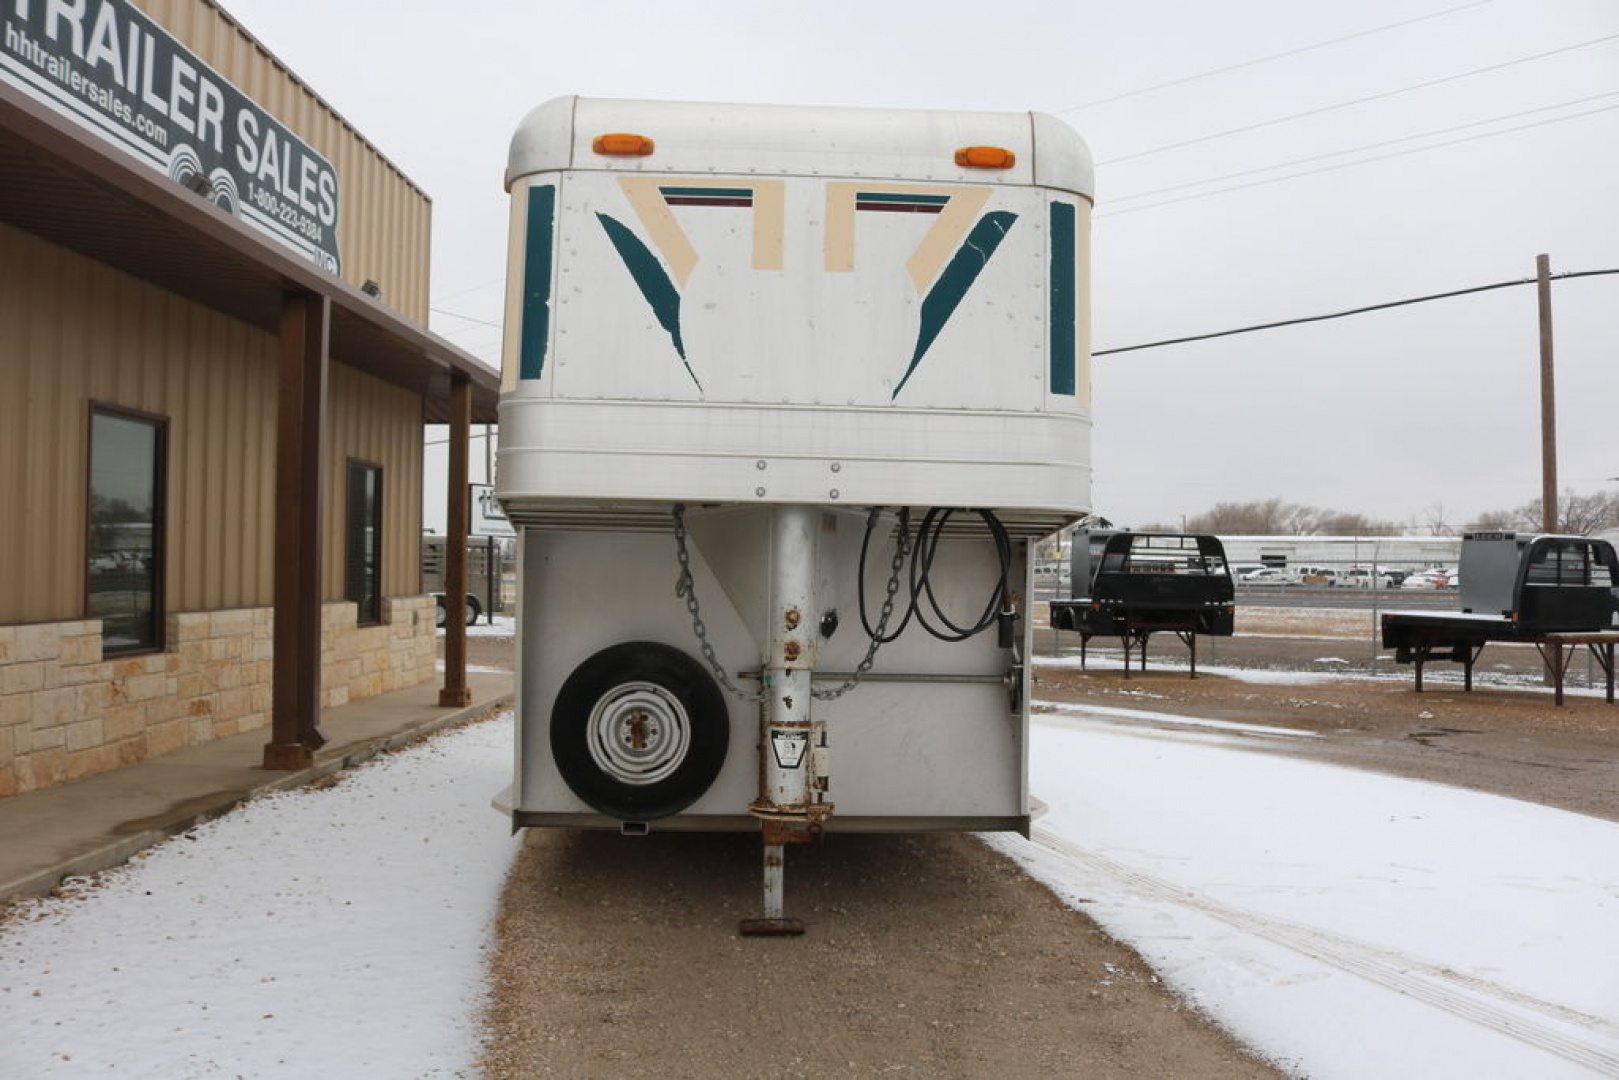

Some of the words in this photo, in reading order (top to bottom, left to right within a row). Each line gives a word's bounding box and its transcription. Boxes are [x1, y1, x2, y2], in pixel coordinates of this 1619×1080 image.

[5, 21, 168, 148] hhtrailersales.com
[15, 0, 225, 154] RAILER
[236, 108, 336, 227] SALES
